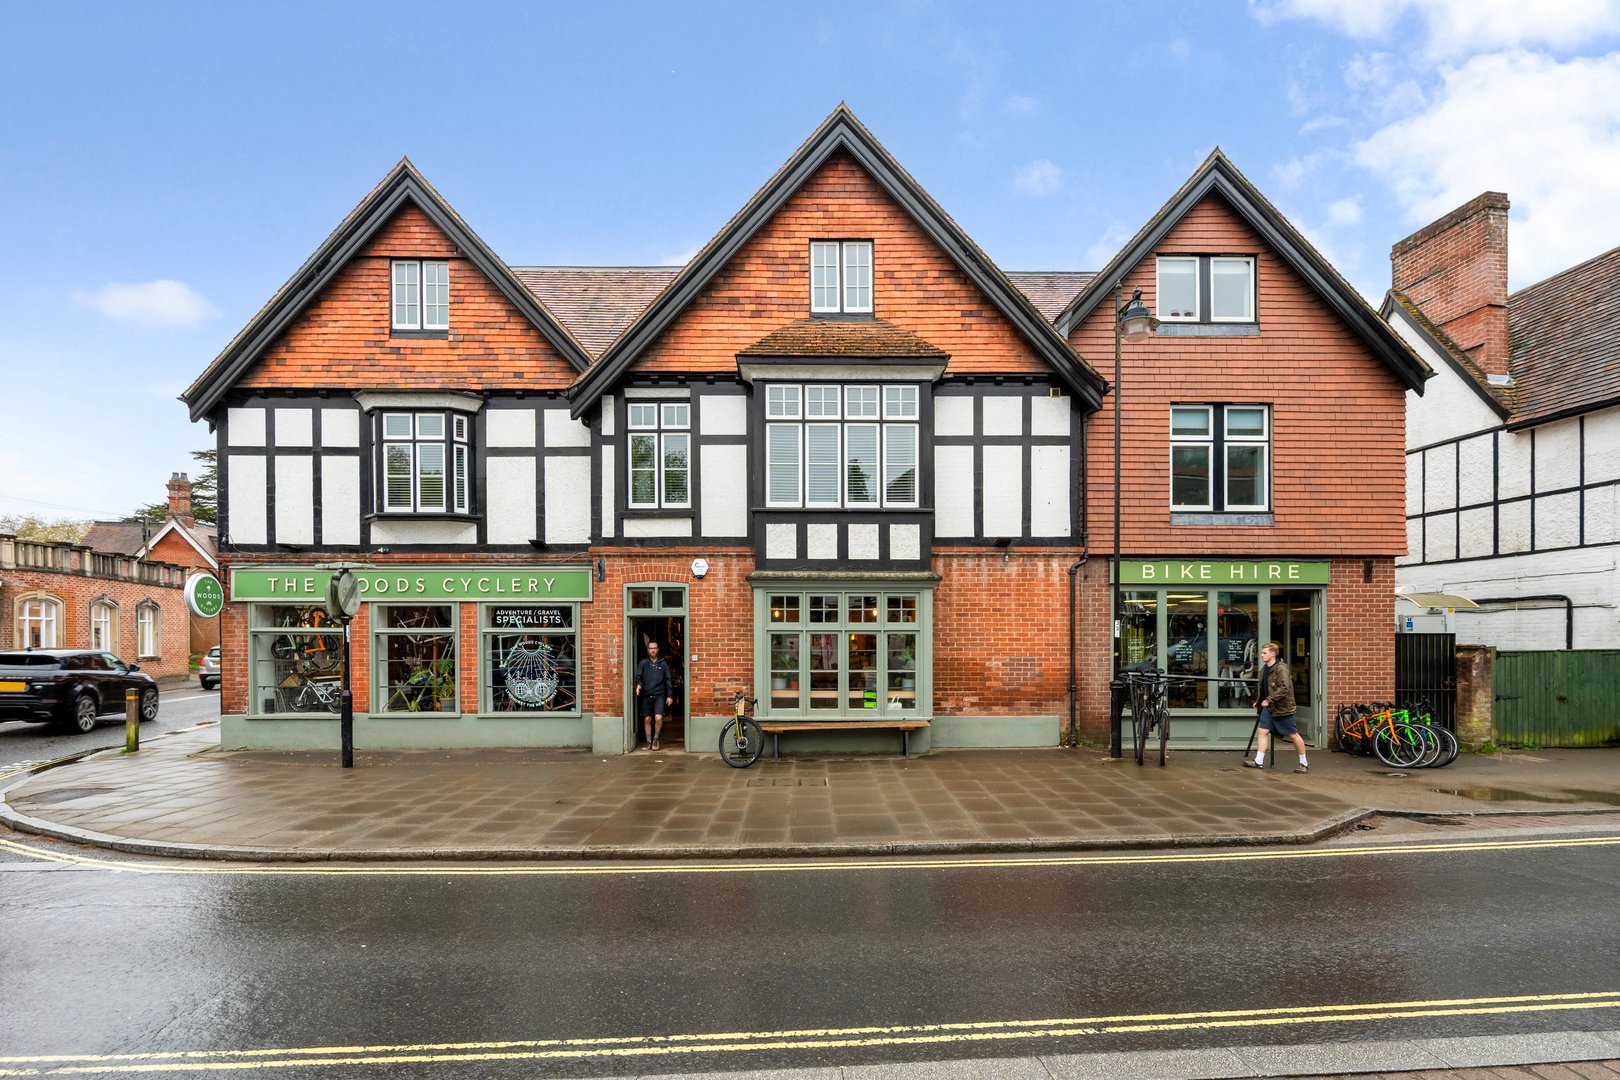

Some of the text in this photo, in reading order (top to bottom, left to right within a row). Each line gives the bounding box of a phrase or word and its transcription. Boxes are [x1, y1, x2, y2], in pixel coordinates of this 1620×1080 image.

[1142, 564, 1300, 579] BIKE HIRE
[267, 577, 555, 593] THE OODS CYCLERY
[196, 592, 221, 600] WOODS
[496, 615, 561, 624] SPECIALISTS
